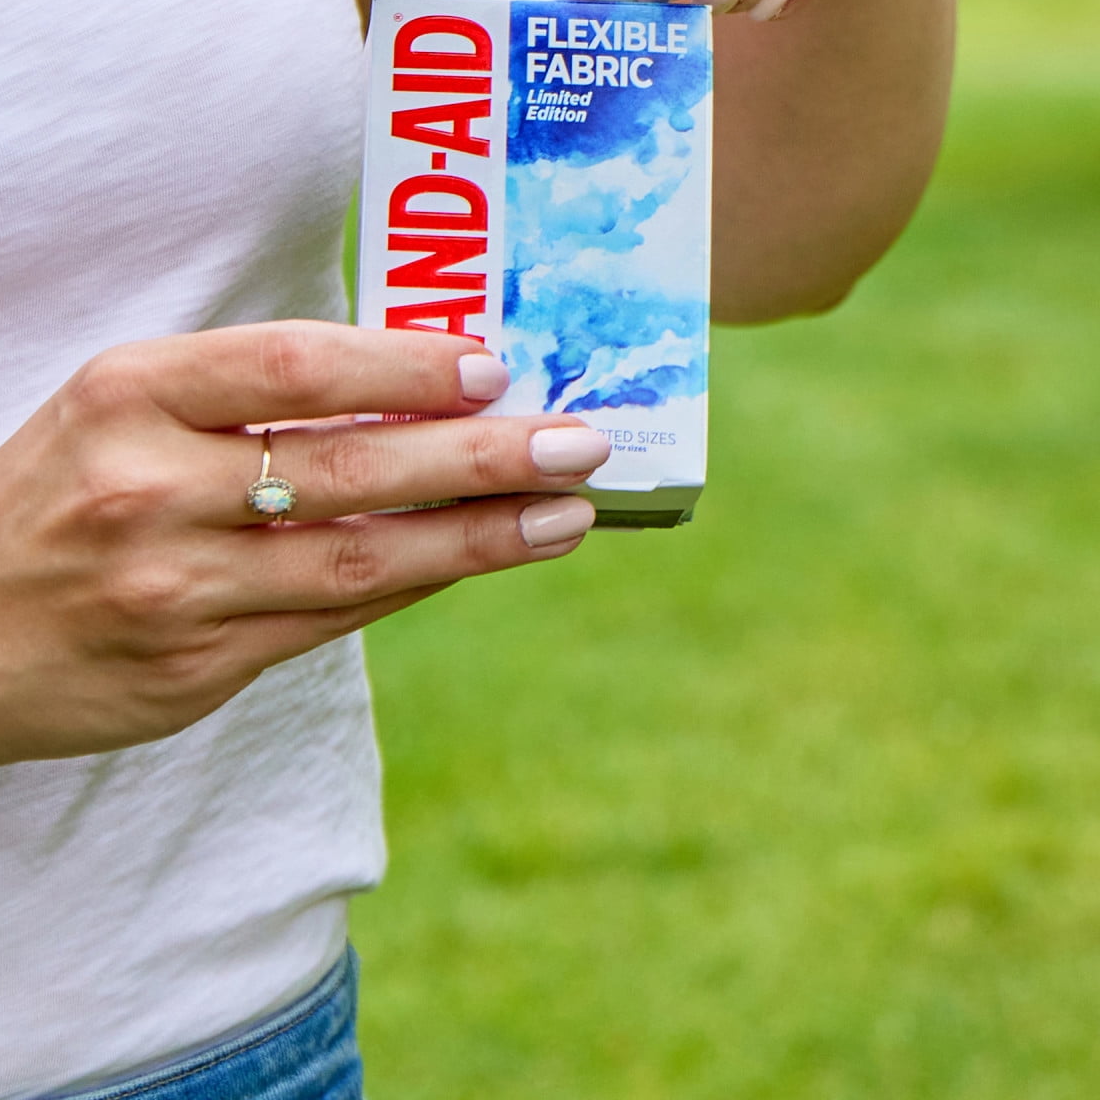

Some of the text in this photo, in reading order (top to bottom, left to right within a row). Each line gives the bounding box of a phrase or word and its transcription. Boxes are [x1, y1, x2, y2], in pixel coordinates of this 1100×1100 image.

[527, 17, 688, 54] FLEXIBLE
[526, 53, 654, 89] FABRIC
[526, 89, 593, 106] Limited
[525, 106, 587, 123] Edition
[386, 15, 493, 346] AND-AID
[637, 431, 676, 445] SIZES
[628, 444, 647, 452] sizes
